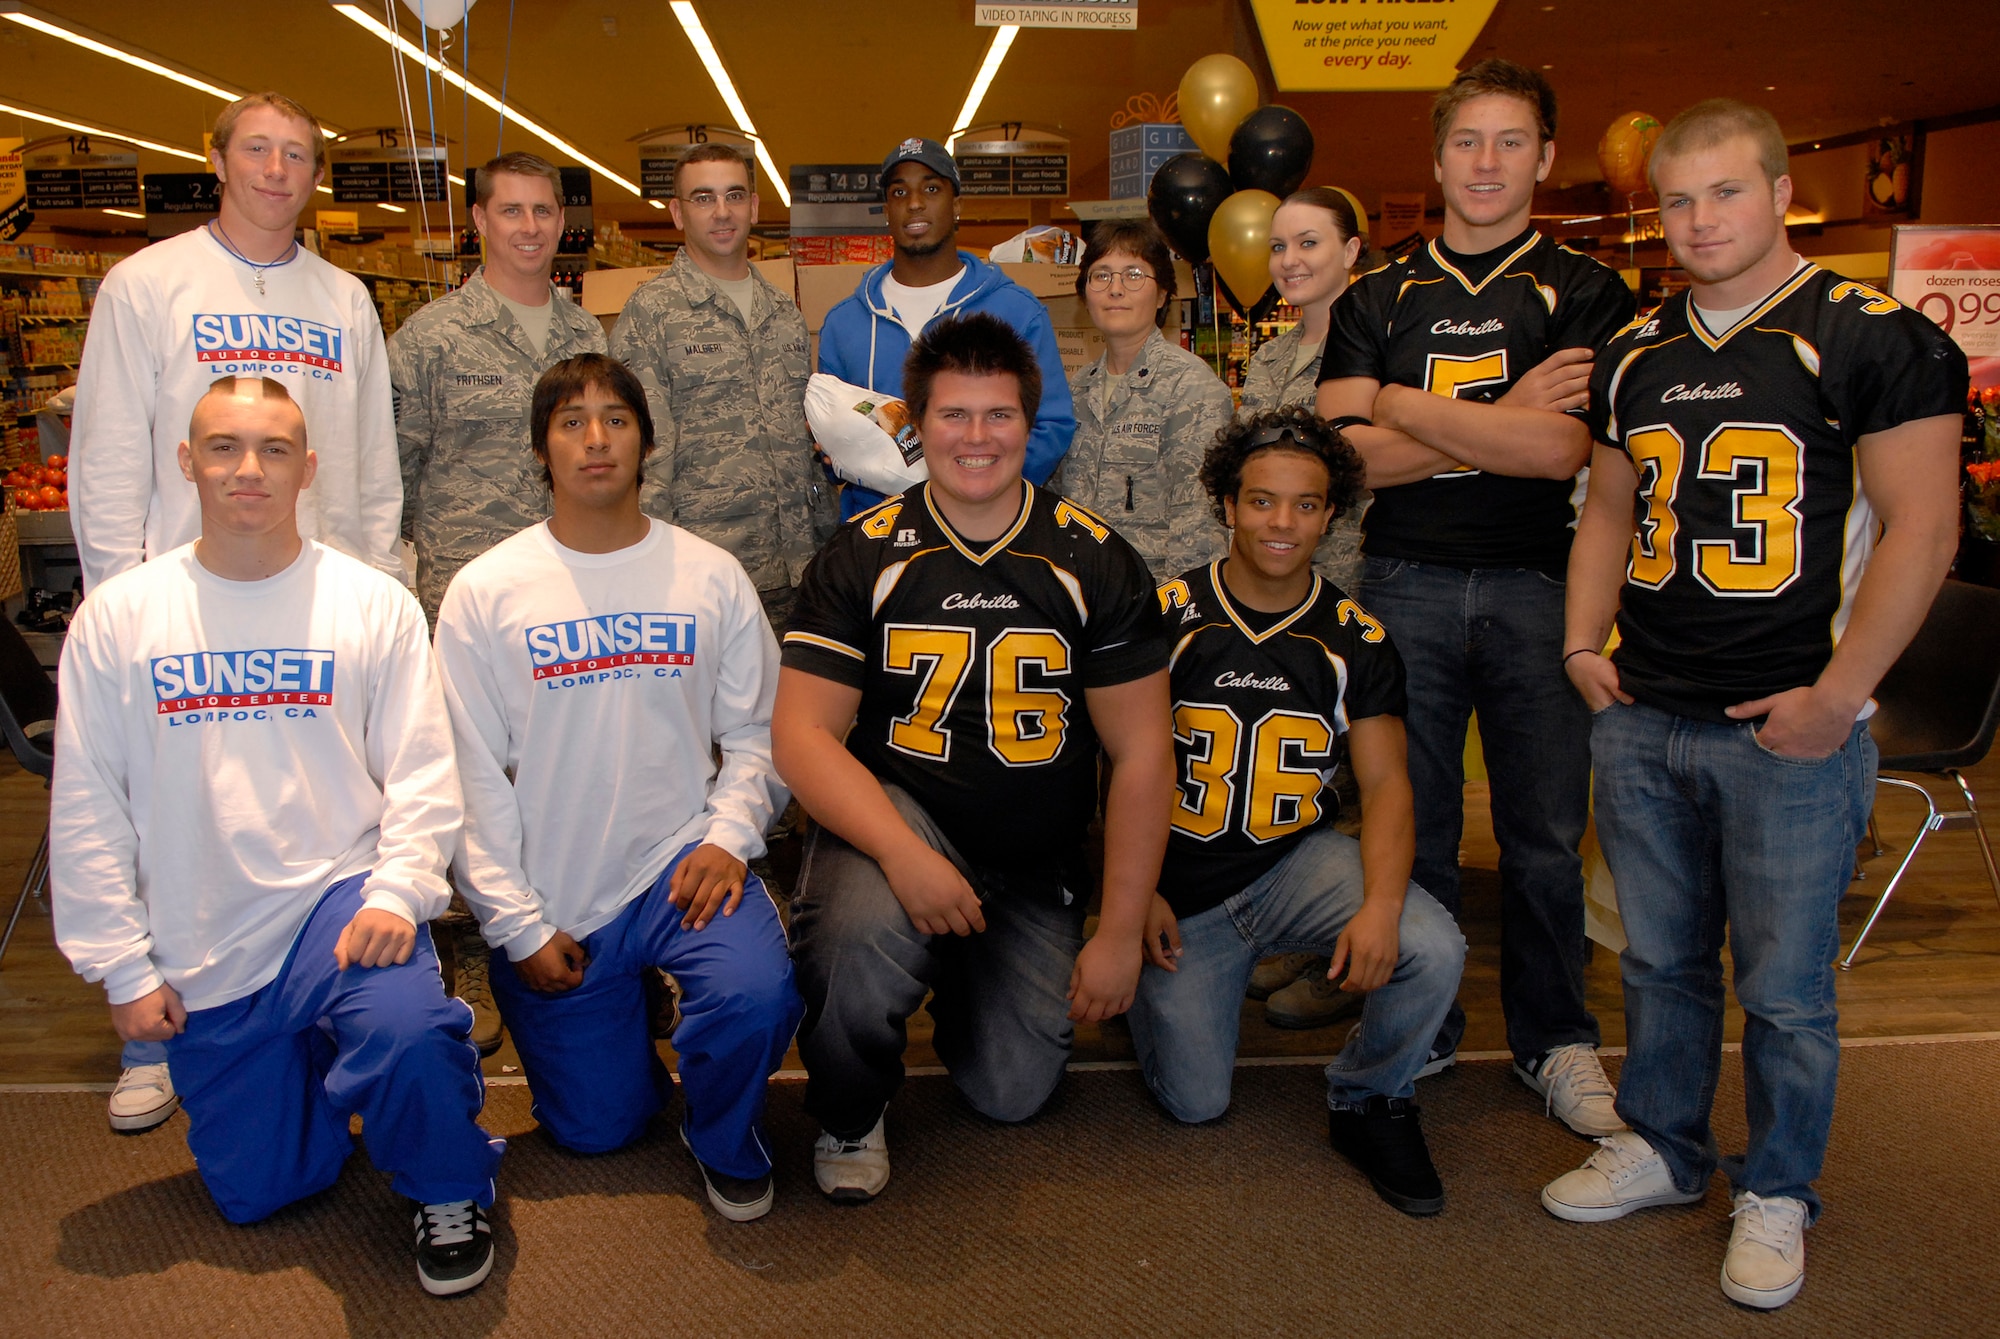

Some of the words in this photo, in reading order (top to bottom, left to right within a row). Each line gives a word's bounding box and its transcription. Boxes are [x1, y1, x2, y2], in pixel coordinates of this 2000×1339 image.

[982, 9, 1015, 21] VIDEO
[1019, 10, 1058, 22] TAPING
[1061, 12, 1073, 22] IN
[1077, 12, 1131, 24] PROGRESS
[1292, 19, 1323, 31] Now
[1326, 20, 1346, 34] get
[1351, 19, 1382, 30] what
[1386, 21, 1410, 33] you
[1413, 19, 1449, 31] want,
[1304, 38, 1316, 47] at
[1320, 36, 1341, 47] the
[1343, 35, 1373, 49] price
[1377, 37, 1400, 49] you
[1404, 34, 1436, 46] need
[1324, 55, 1373, 70] every
[1377, 51, 1412, 69] day.
[376, 128, 398, 148] 15
[686, 125, 708, 144] 16
[1001, 121, 1022, 141] 17
[1149, 132, 1185, 144] GIF
[67, 135, 91, 155] 14
[1112, 132, 1138, 150] GIFT
[963, 158, 982, 166] pasta
[1016, 157, 1043, 166] hispanic
[1112, 157, 1139, 173] CARD
[42, 171, 62, 179] cereal
[107, 169, 136, 177] breakfast
[645, 174, 664, 182] salad
[89, 184, 104, 192] jams
[112, 183, 133, 192] jellies
[342, 179, 369, 187] cooking
[960, 185, 986, 194] ackaged
[987, 184, 1010, 192] dinners
[1018, 184, 1040, 192] kosher
[1042, 184, 1062, 192] foods
[51, 198, 74, 206] snacks
[85, 197, 113, 207] pancake
[120, 198, 139, 207] syrup
[808, 193, 838, 203] Regular
[840, 193, 859, 201] Price
[164, 202, 193, 212] Regular
[195, 201, 214, 210] Price
[1926, 275, 1965, 287] dozen
[1430, 318, 1504, 336] Cabrillo
[196, 315, 340, 359] SUNSET
[1058, 330, 1084, 339] PRODUCT
[1961, 331, 1998, 340] everyday
[685, 343, 722, 356] MALGIERI
[202, 351, 341, 371] AUTOCENTER
[211, 363, 306, 377] LOMPOC,
[312, 369, 333, 382] CA
[456, 374, 502, 386] FRITHSEN
[1660, 381, 1744, 404] Cabrillo
[1122, 423, 1132, 433] AIR
[1133, 423, 1160, 434] FORCE
[1625, 421, 1806, 598] 33
[941, 592, 1020, 610] Cabrillo
[528, 613, 695, 666] SUNSET
[153, 650, 334, 700] SUNSET
[654, 667, 683, 678] CA
[1213, 670, 1291, 692] Cabrillo
[883, 622, 1072, 768] 76
[284, 707, 319, 719] CA
[1170, 699, 1335, 845] 36
